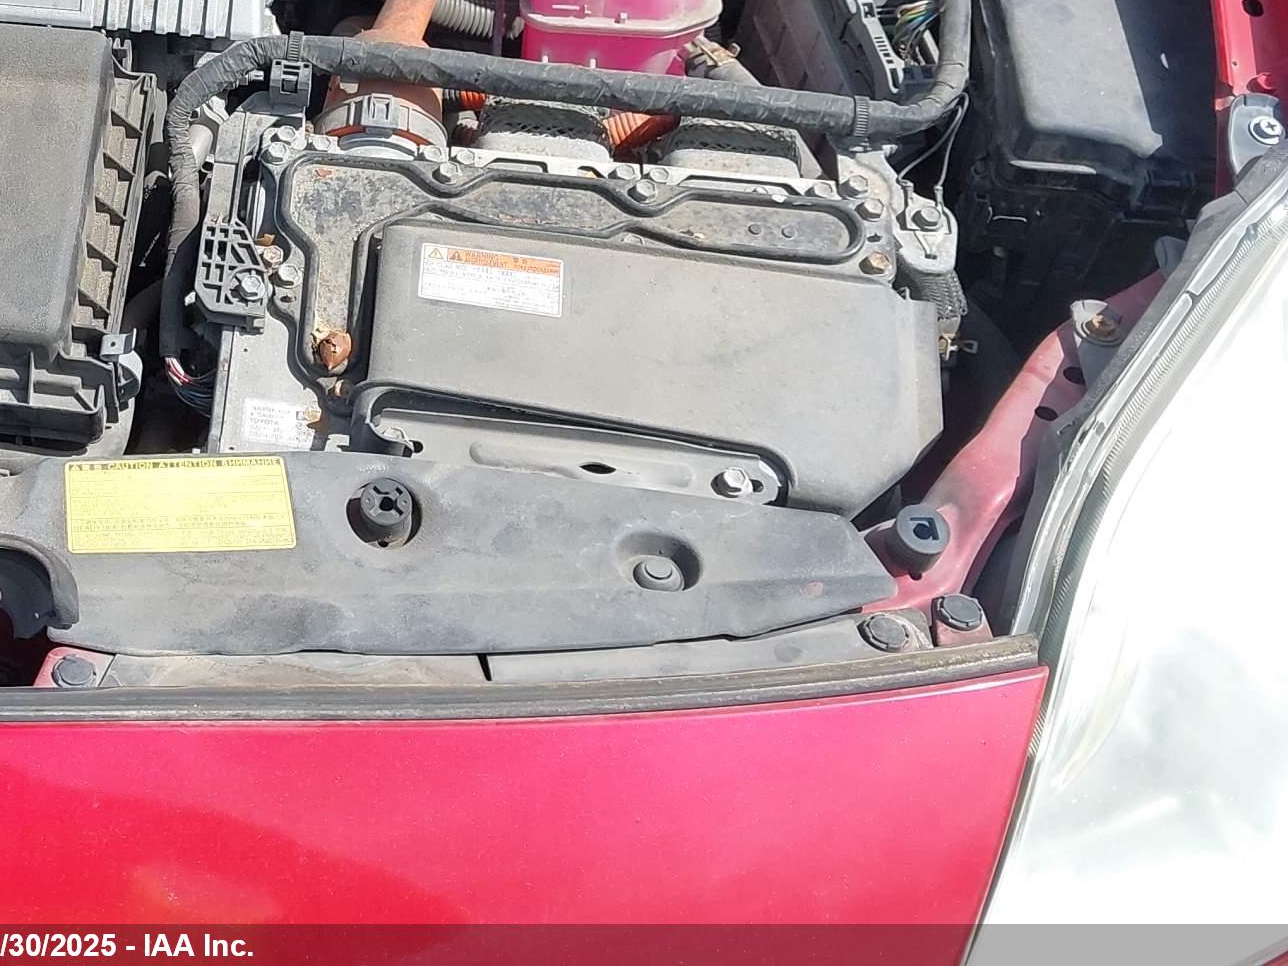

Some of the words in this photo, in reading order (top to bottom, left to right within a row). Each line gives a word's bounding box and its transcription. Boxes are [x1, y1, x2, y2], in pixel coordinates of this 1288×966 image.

[108, 462, 152, 471] CAUTION
[158, 460, 216, 469] ATTENTION
[223, 458, 280, 467] ВНИМАНИЕ
